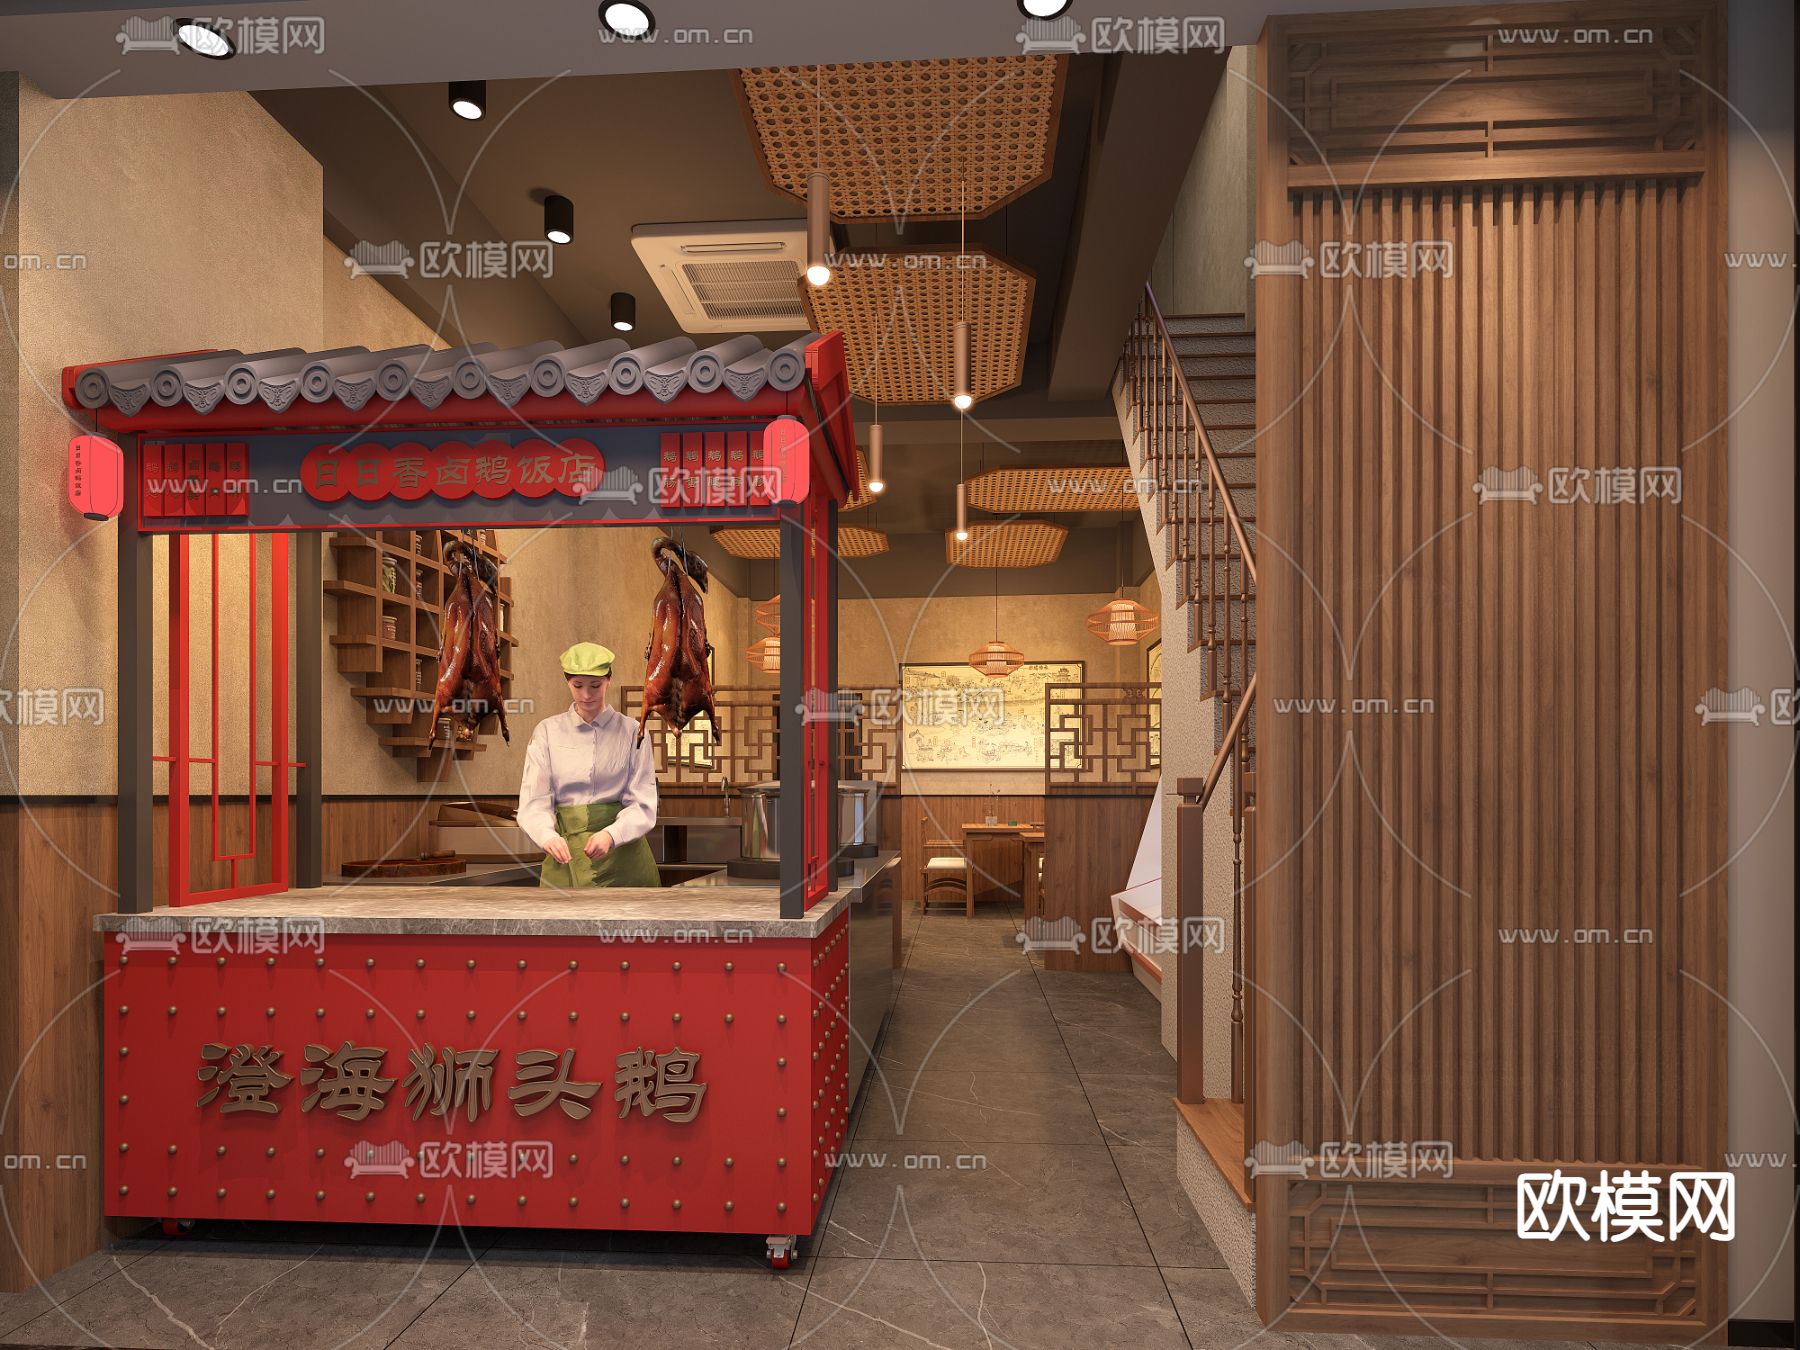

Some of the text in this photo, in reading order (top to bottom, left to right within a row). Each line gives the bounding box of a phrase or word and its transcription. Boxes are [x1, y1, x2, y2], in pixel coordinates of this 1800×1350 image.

[315, 452, 597, 489] 日日香卤鹅饭店
[197, 1040, 707, 1123] 澄海狮头鹅
